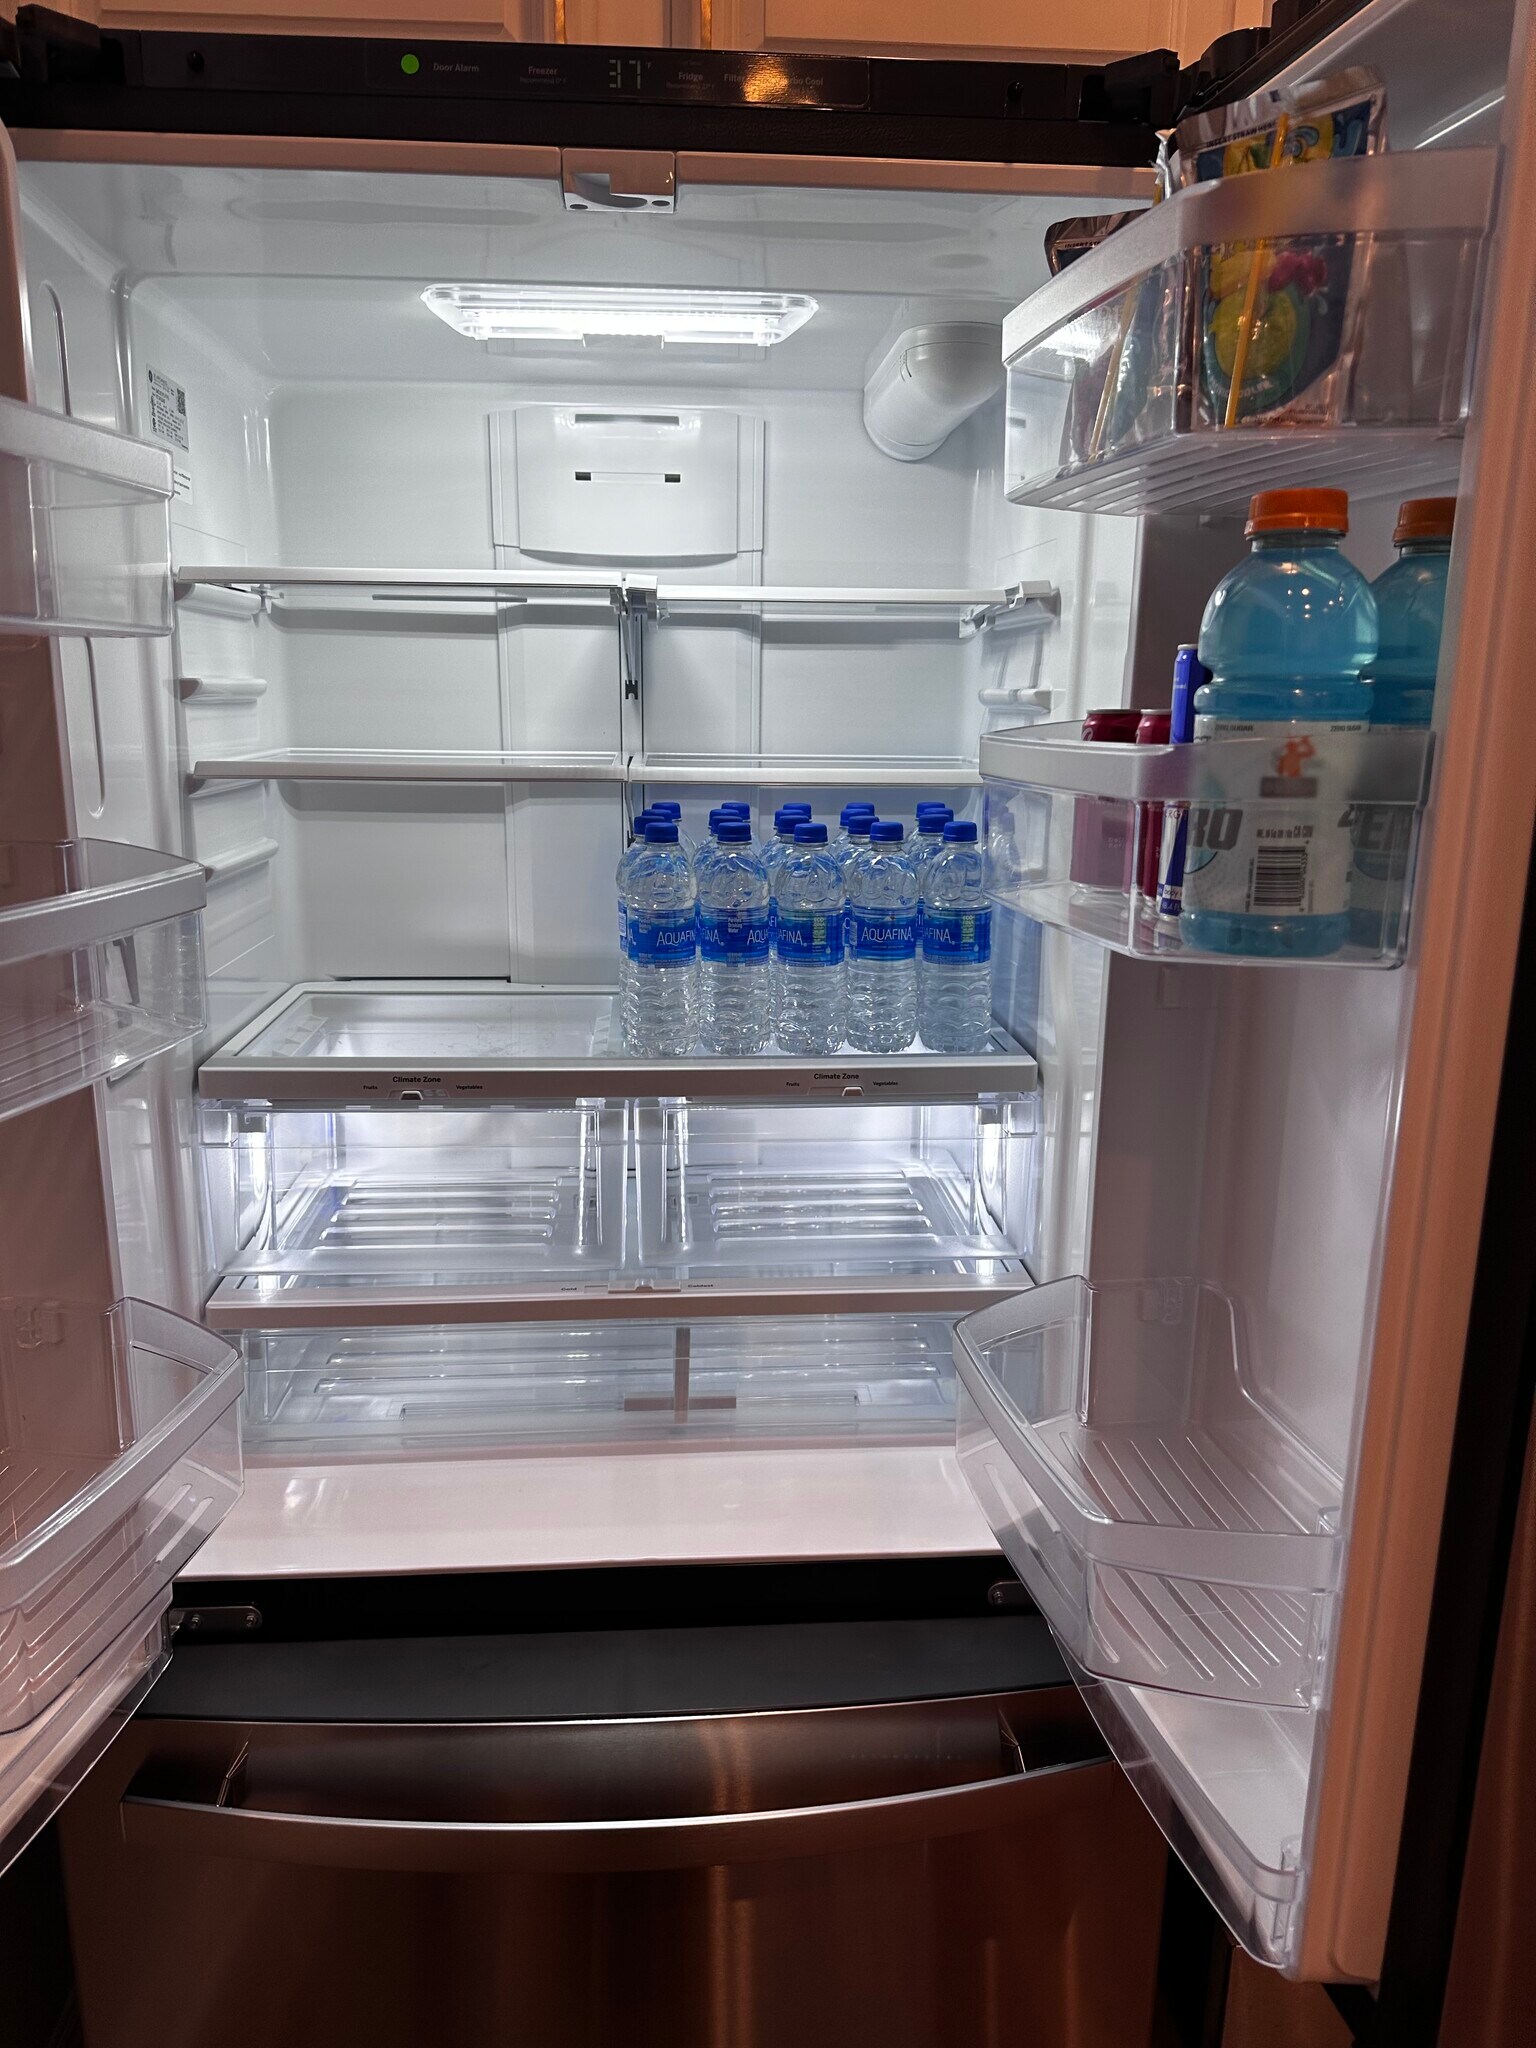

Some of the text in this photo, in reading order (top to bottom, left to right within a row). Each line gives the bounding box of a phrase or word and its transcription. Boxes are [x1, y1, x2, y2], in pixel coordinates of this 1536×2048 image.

[433, 62, 480, 73] Door Alarm
[528, 66, 558, 76] Freezer
[609, 59, 641, 89] 37
[678, 71, 704, 82] Fridge
[805, 76, 824, 86] Cool
[1206, 134, 1232, 148] INSERT
[1233, 126, 1257, 141] STRAW
[861, 926, 913, 943] AQUAFINA
